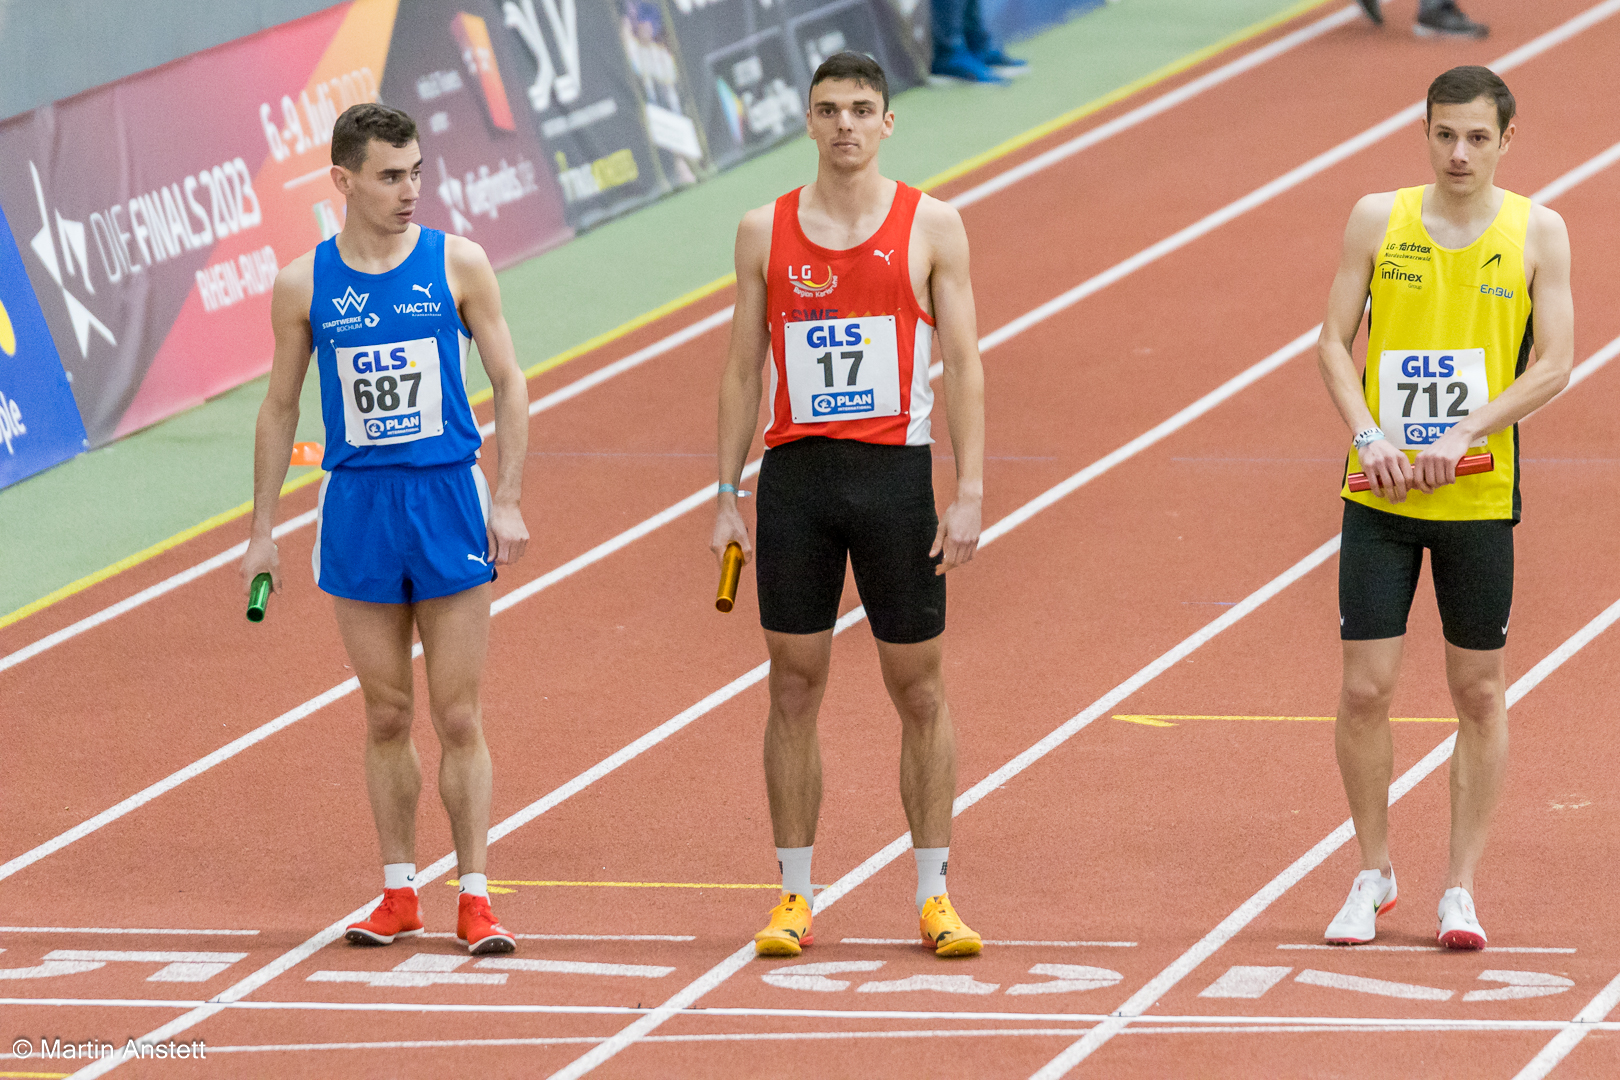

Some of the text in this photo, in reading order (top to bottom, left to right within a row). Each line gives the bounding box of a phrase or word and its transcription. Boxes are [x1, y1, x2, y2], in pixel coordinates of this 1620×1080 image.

[89, 157, 262, 284] DIE FINALS 2023
[195, 245, 279, 313] RHEIN-RUHR
[1381, 268, 1423, 283] infinex
[1480, 284, 1514, 299] EnBW
[393, 302, 442, 314] VIACTIV
[322, 316, 362, 329] STADTWERKE
[336, 323, 363, 333] BOCHUM
[816, 350, 864, 388] 17
[353, 371, 422, 414] 687
[837, 393, 872, 406] PLAN
[1396, 381, 1470, 418] 712
[386, 416, 420, 430] PLAN
[760, 960, 1125, 995] 3
[1197, 965, 1576, 1002] 2
